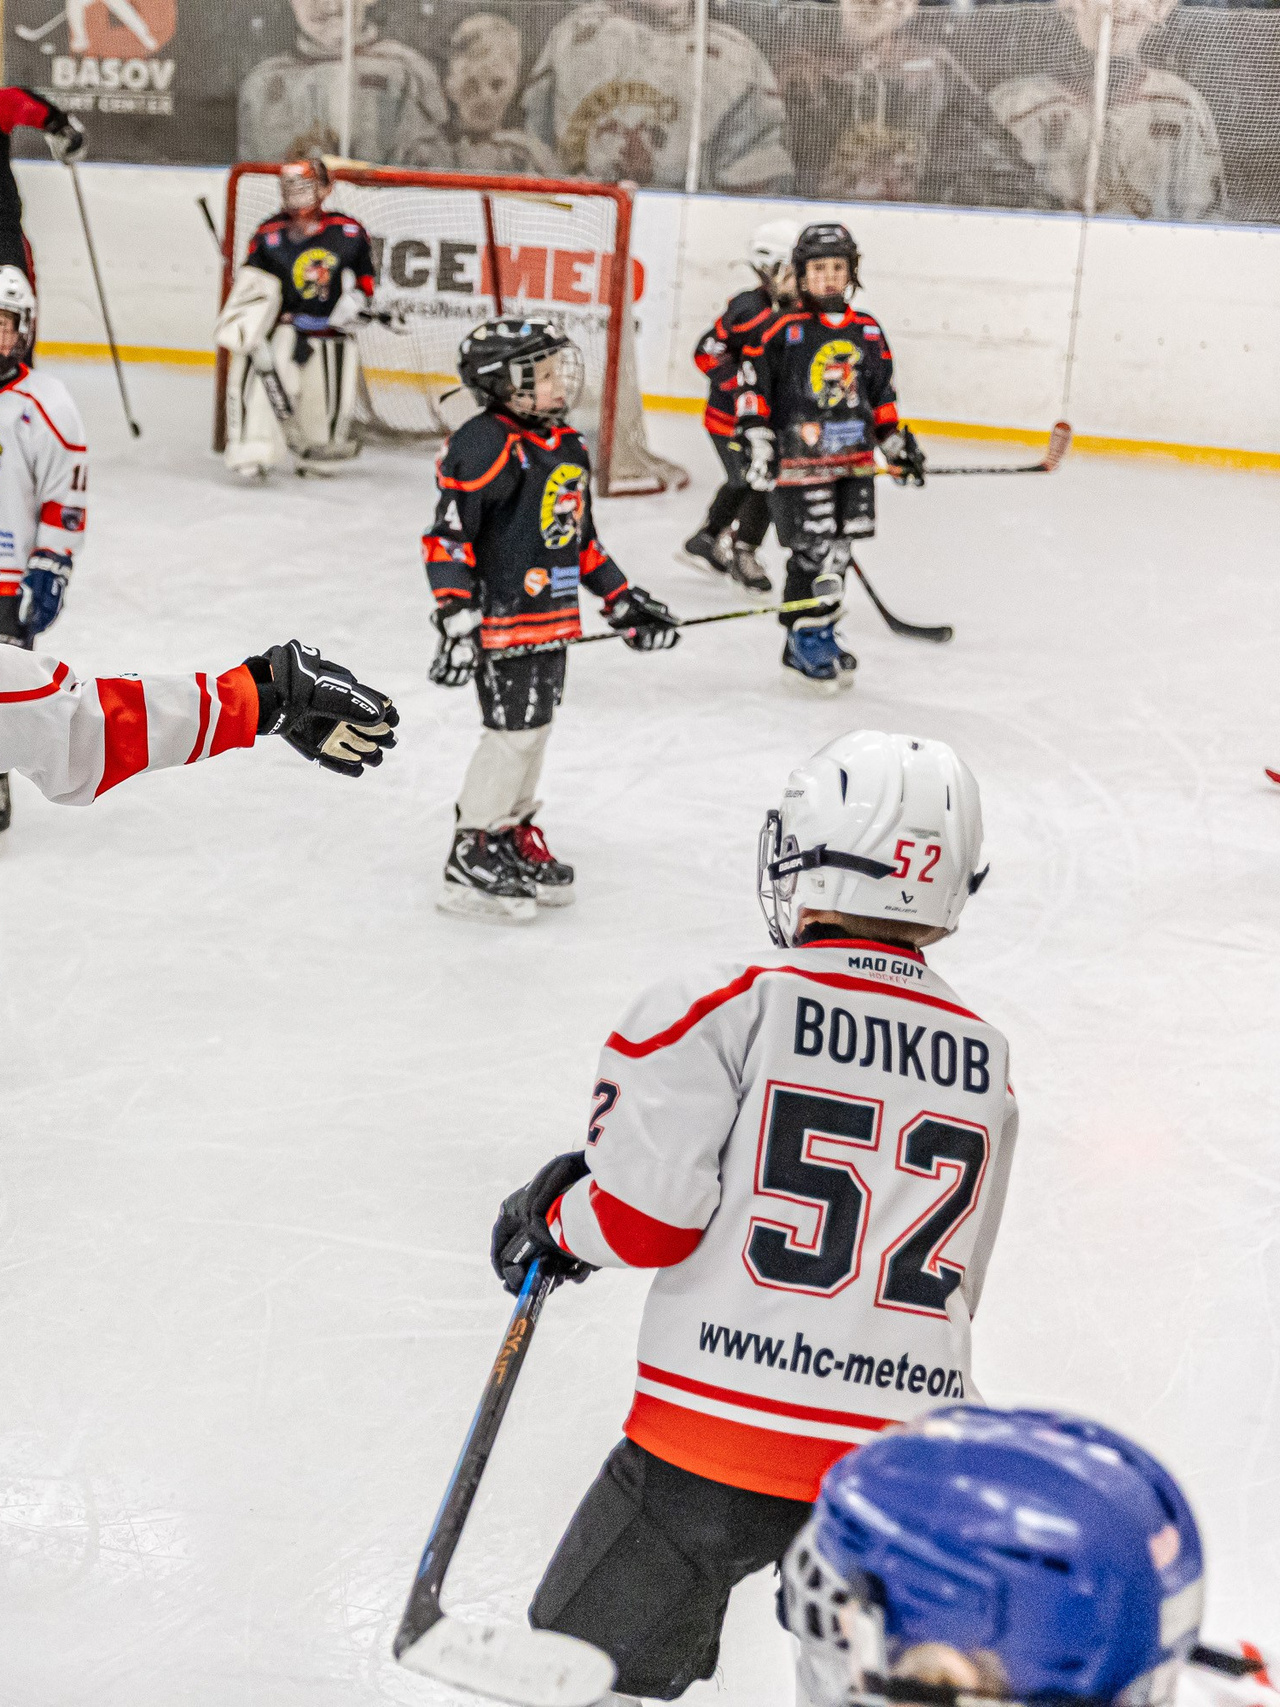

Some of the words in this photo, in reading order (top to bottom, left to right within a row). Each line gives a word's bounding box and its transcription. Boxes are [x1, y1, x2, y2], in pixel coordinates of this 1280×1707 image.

[52, 56, 176, 90] BASOV
[350, 697, 376, 715] CCM
[889, 838, 942, 884] 52
[884, 904, 918, 914] BAUER
[847, 956, 888, 972] MAD
[890, 960, 924, 980] GUY
[868, 971, 908, 984] HOCKEY
[793, 996, 991, 1095] ВОЛКОВ
[742, 1079, 991, 1322] 52
